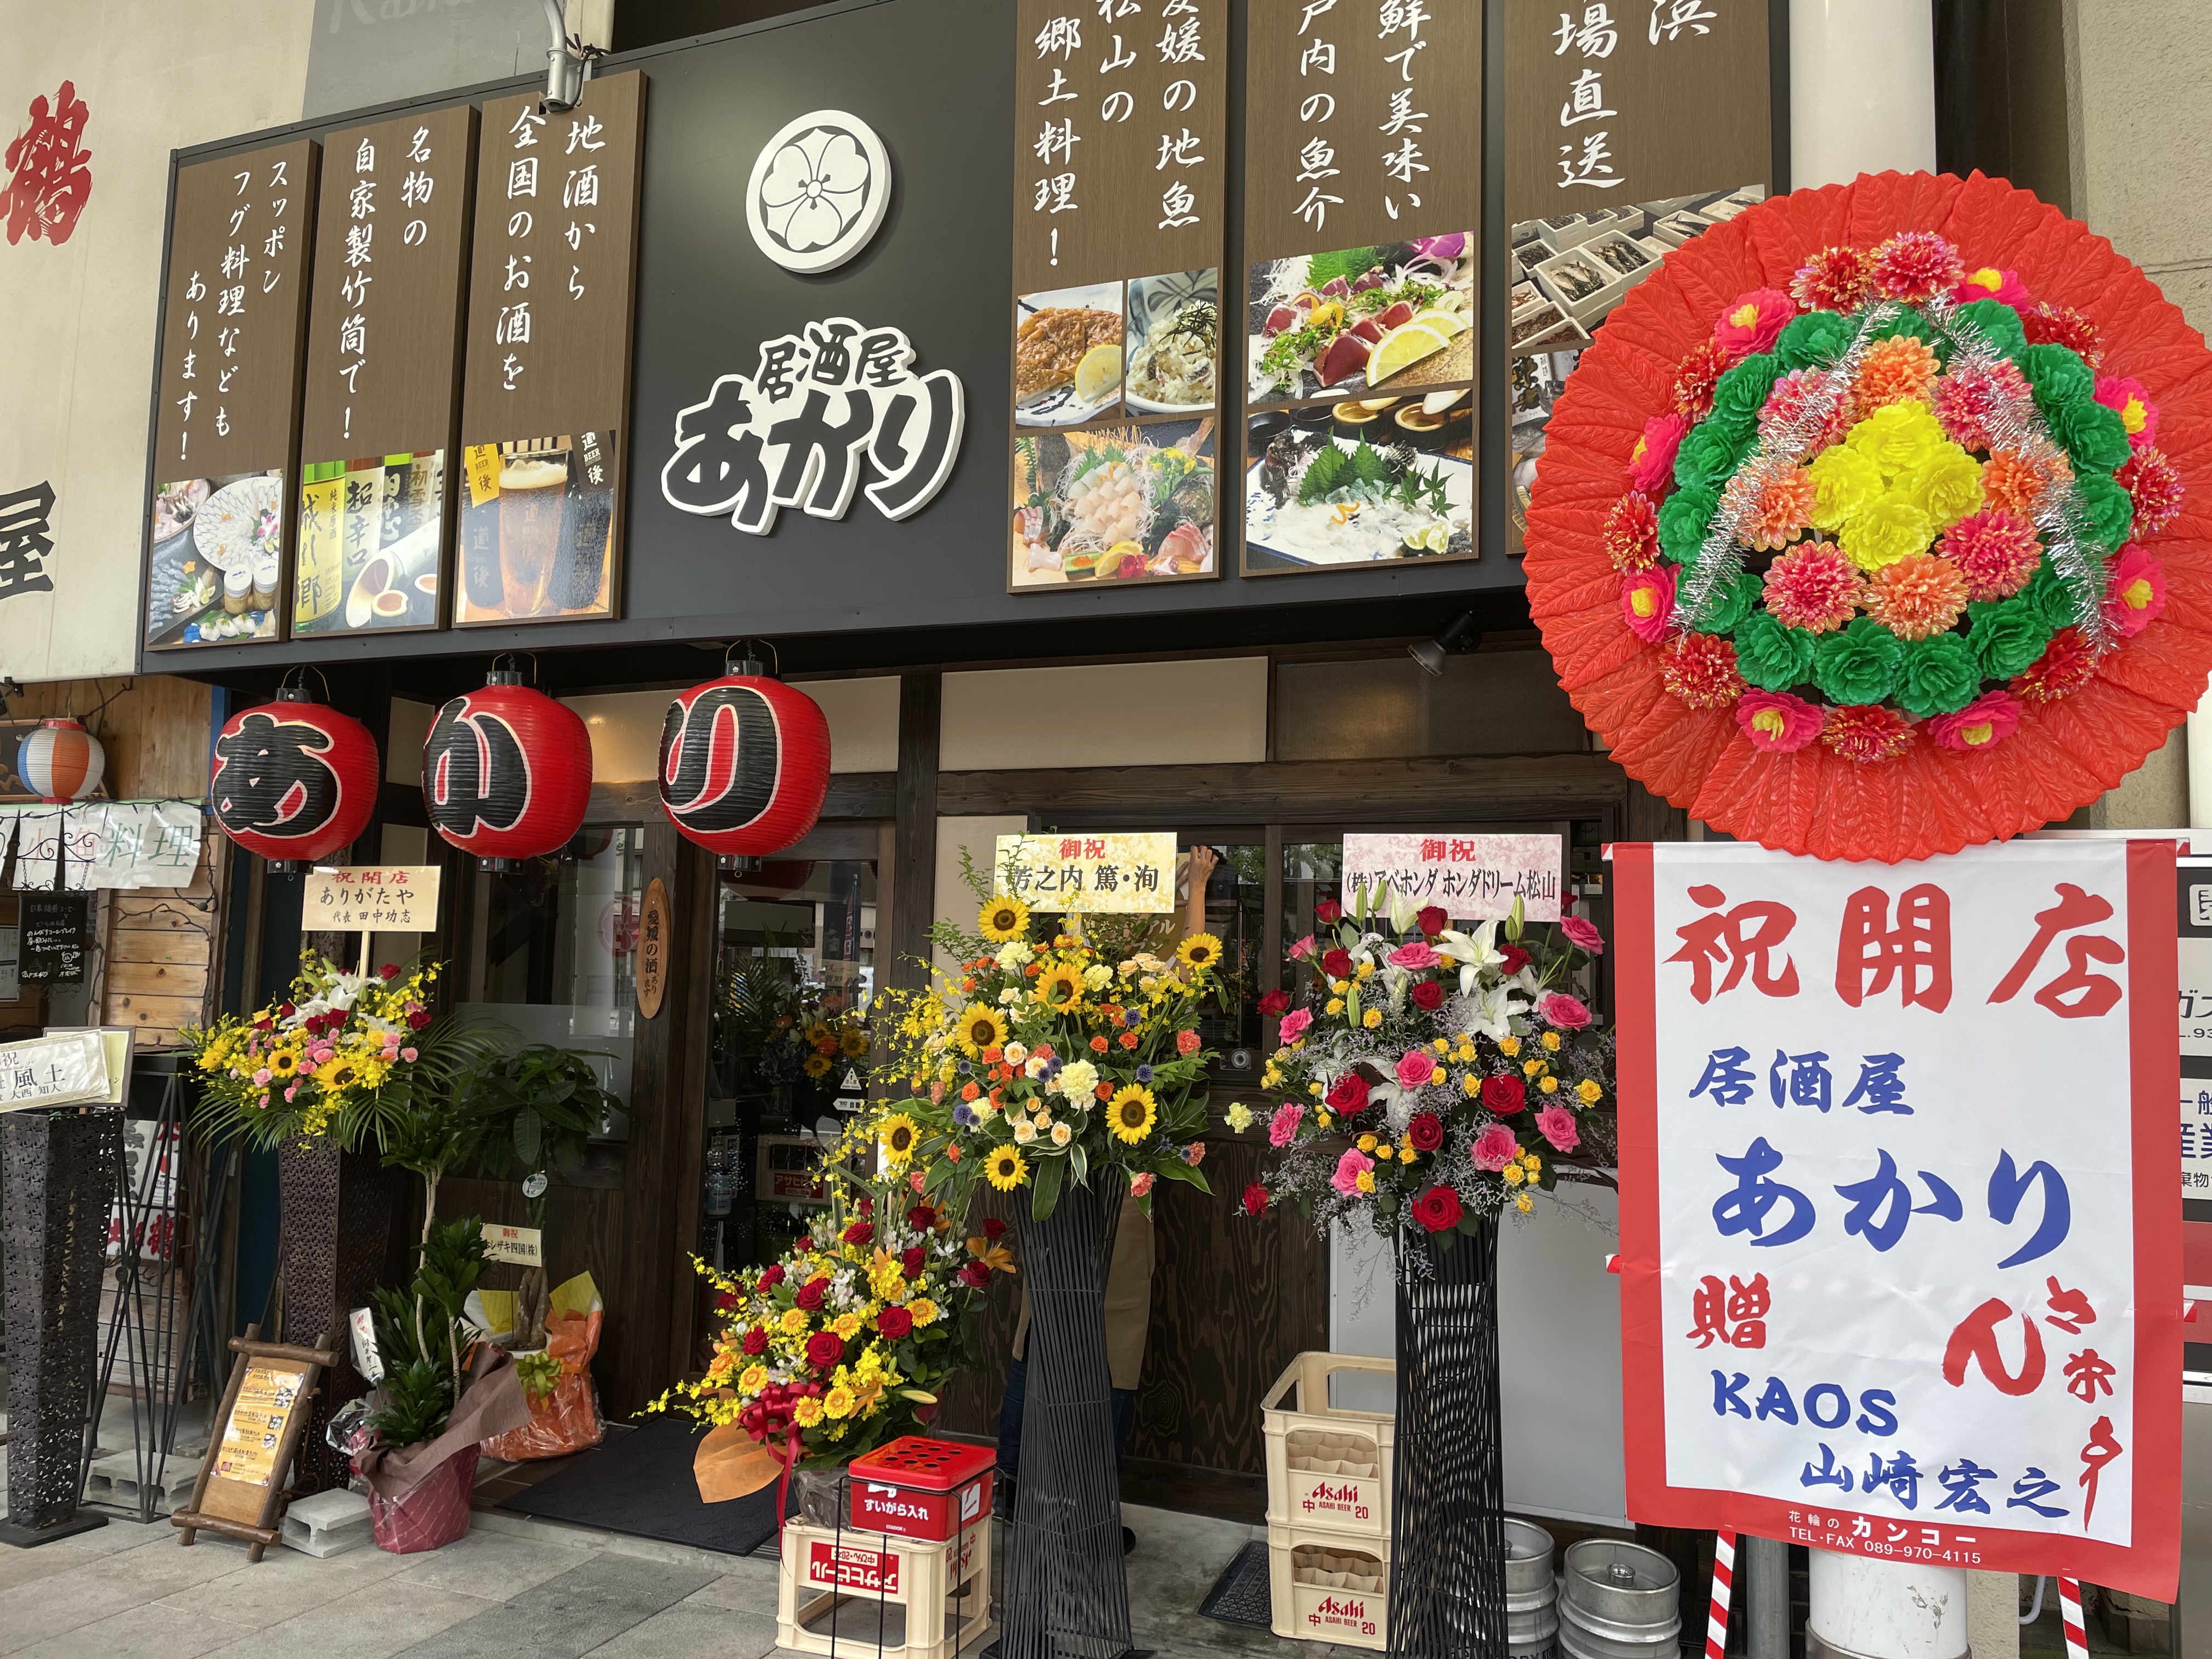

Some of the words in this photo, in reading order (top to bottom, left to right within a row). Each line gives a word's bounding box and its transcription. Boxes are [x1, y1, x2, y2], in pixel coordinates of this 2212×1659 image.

[1551, 0, 1626, 188] 場直送
[1034, 16, 1081, 266] 郷土料理!
[400, 126, 433, 246] 名物の
[563, 115, 606, 300] 地酒から
[263, 161, 288, 294] スッポン
[496, 106, 546, 390] 全国のお酒を
[216, 172, 250, 437] フグ料理なども
[339, 138, 376, 439] 自家製竹筒で!
[176, 270, 206, 460] あります!
[757, 323, 908, 405] 居酒屋
[583, 448, 601, 462] BEER
[664, 373, 957, 529] あかり
[331, 871, 411, 885] 祝開店
[1059, 838, 1106, 860] 御祝
[1419, 838, 1477, 862] 御祝
[320, 887, 414, 906] ありがたや
[1442, 868, 1556, 901] ホンダドリーム松山
[645, 909, 659, 975] 愛媛の酒
[1663, 882, 2126, 1019] 祝開店
[1689, 1046, 1915, 1116] 居酒屋
[1712, 1136, 2072, 1269] あかり
[1686, 1272, 1771, 1350] 贈
[1710, 1369, 1899, 1437] KAOS
[864, 1498, 929, 1521] すいがら入れ
[1312, 1481, 1358, 1504] Asahi
[1318, 1501, 1335, 1510] ASAHI
[1337, 1503, 1351, 1513] BEER
[1355, 1505, 1369, 1520] 20
[1788, 1510, 1840, 1530] 花輪の
[1851, 1515, 1977, 1547] カンコー
[1863, 1539, 1982, 1565] 089-970-4115
[1318, 1596, 1364, 1619] Asahi
[1325, 1616, 1342, 1625] ASAHI
[1344, 1618, 1358, 1628] BEER
[1362, 1621, 1376, 1636] 20
